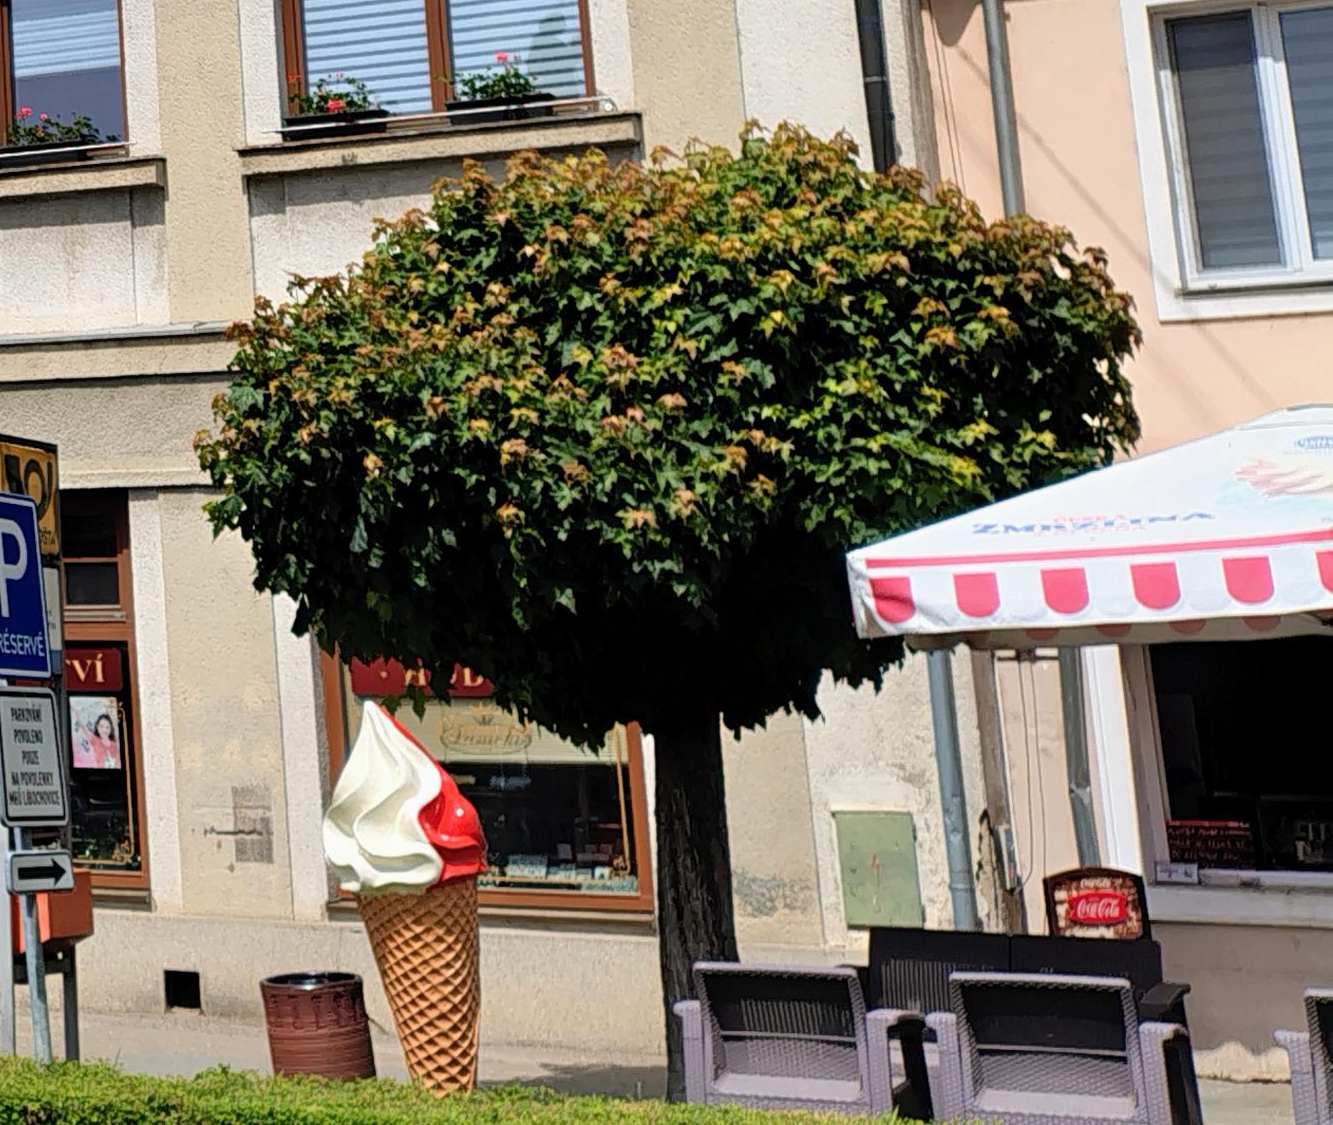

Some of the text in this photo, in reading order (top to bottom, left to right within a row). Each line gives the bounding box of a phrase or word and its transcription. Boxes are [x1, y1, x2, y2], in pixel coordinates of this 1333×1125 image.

[13, 728, 44, 744] POVOLENO
[21, 750, 40, 765] POUZE
[11, 771, 19, 786] NA
[23, 790, 61, 806] LIBOCHOVICE
